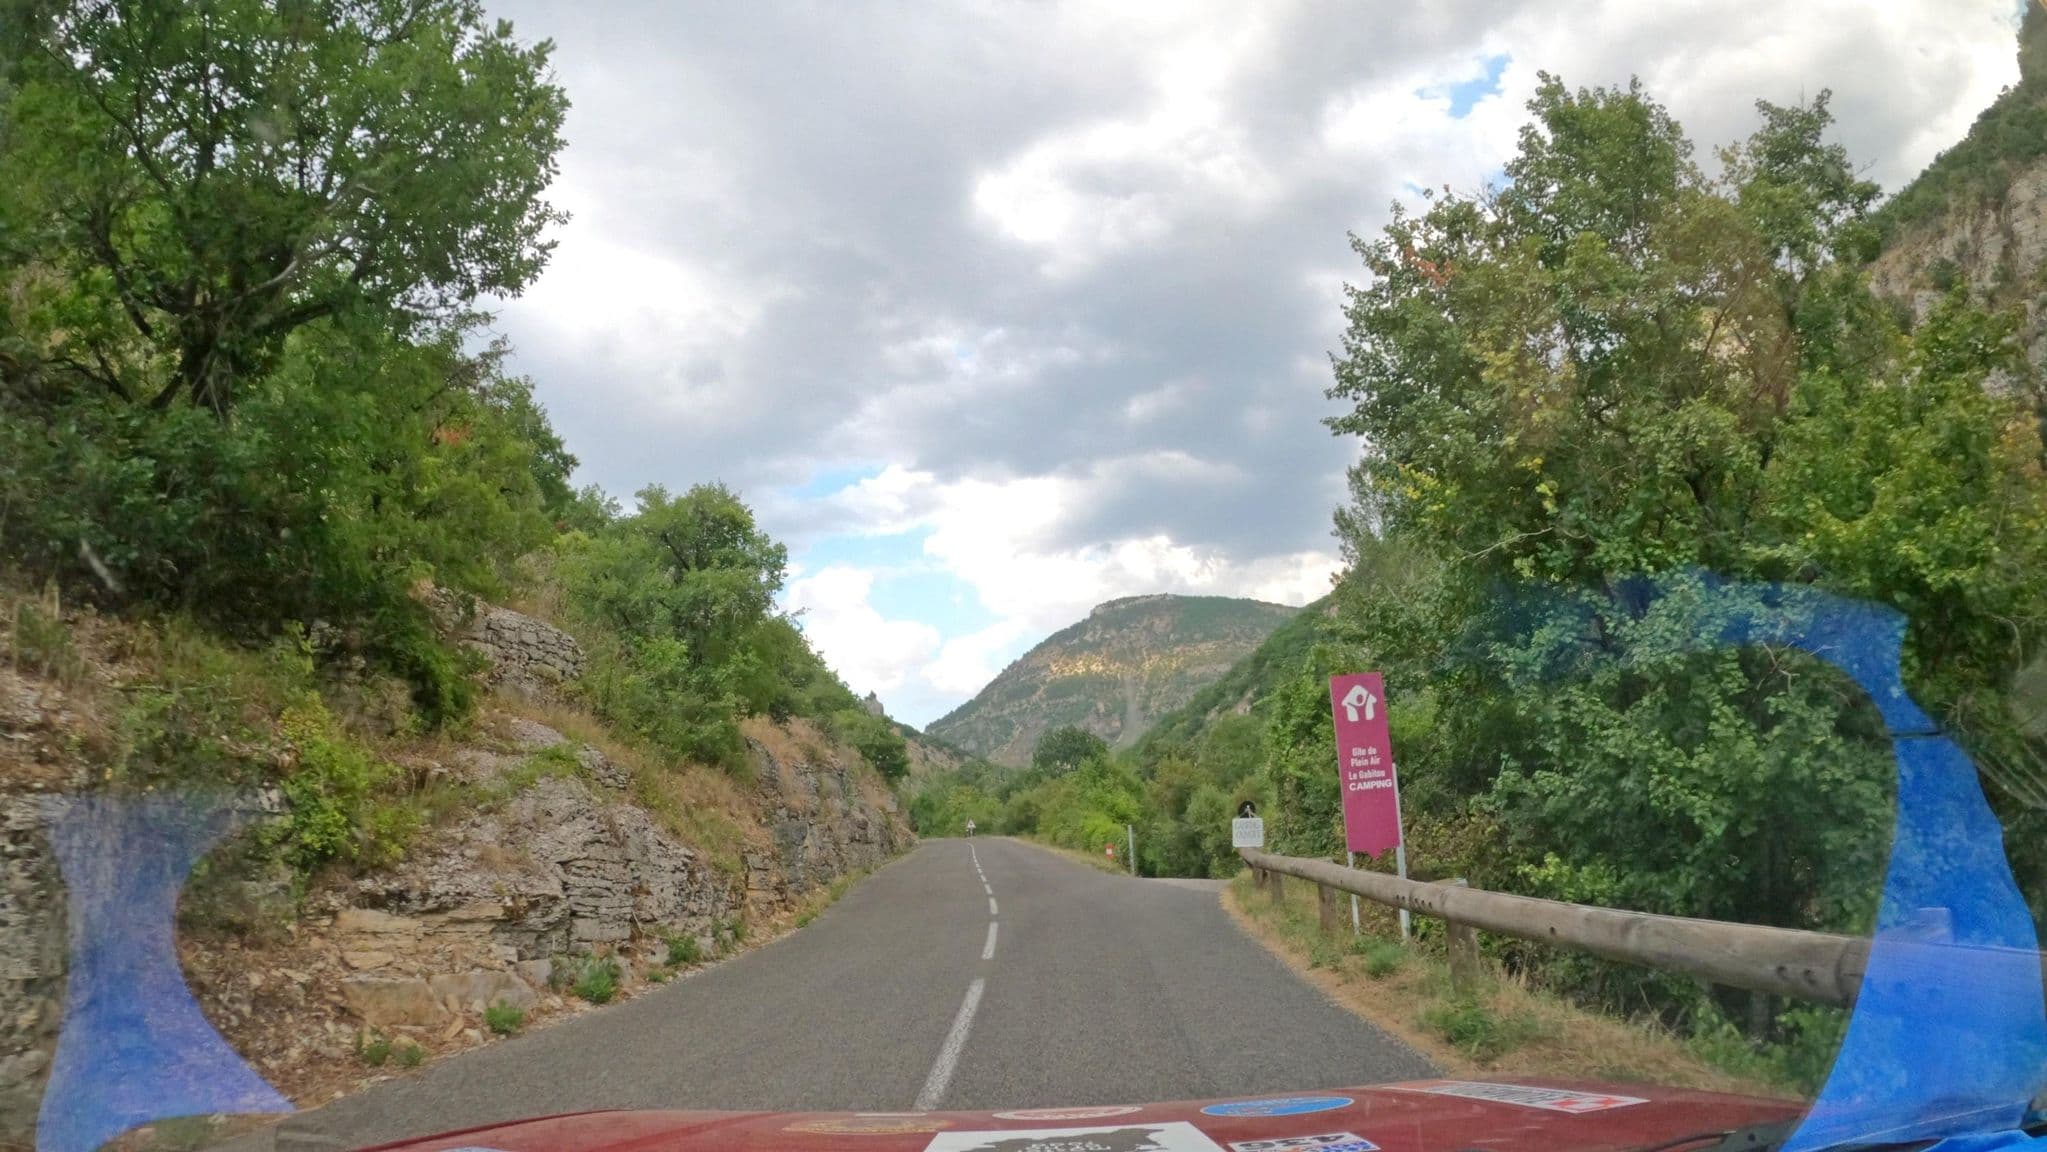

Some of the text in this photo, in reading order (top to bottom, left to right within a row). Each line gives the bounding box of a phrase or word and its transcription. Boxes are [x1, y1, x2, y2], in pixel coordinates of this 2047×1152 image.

[1367, 745, 1377, 755] de
[1350, 756, 1381, 767] Plein Air
[1348, 771, 1358, 780] Le
[1349, 778, 1393, 791] CAMPING
